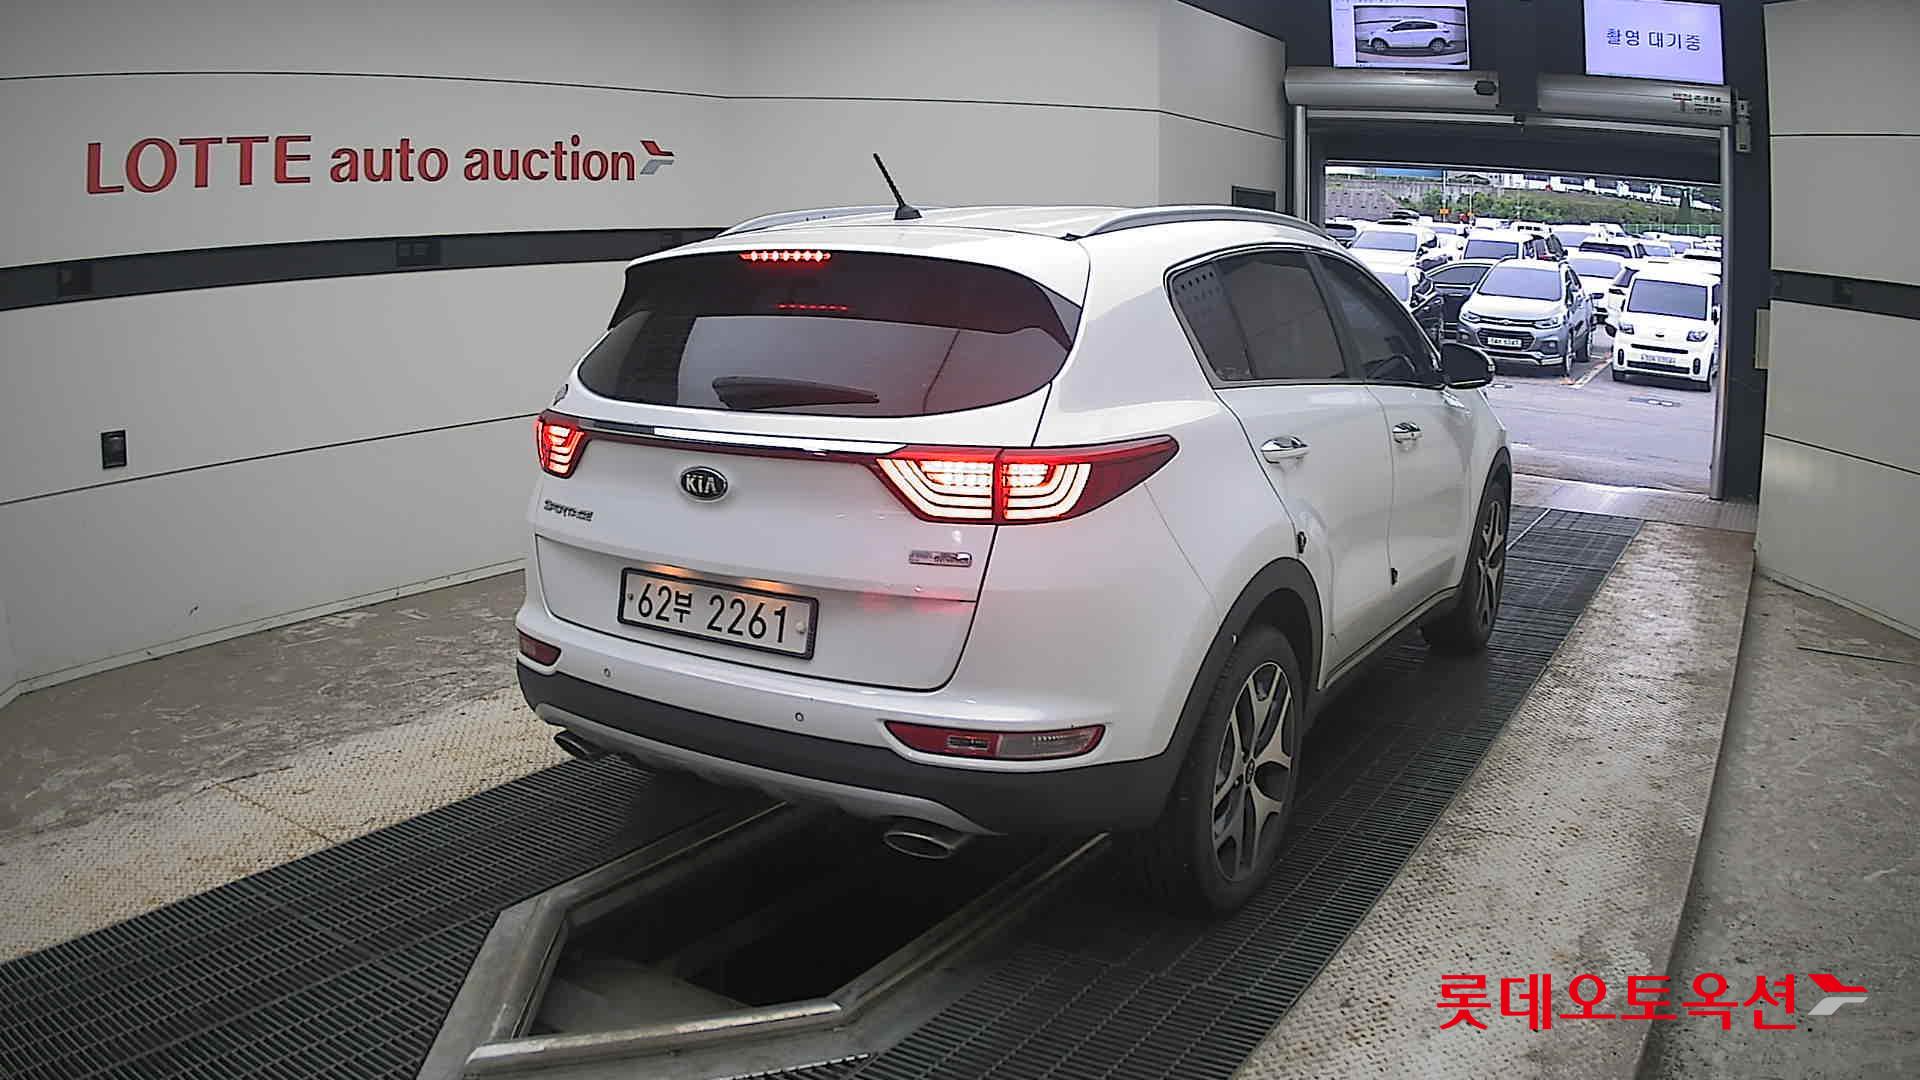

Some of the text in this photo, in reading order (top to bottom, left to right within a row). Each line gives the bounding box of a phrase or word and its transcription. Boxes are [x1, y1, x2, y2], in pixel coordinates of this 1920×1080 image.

[1607, 28, 1701, 51] 촬영 대기중
[87, 134, 636, 194] LOTTE auto auction
[685, 474, 717, 495] KIA
[638, 583, 788, 643] 62부 2261
